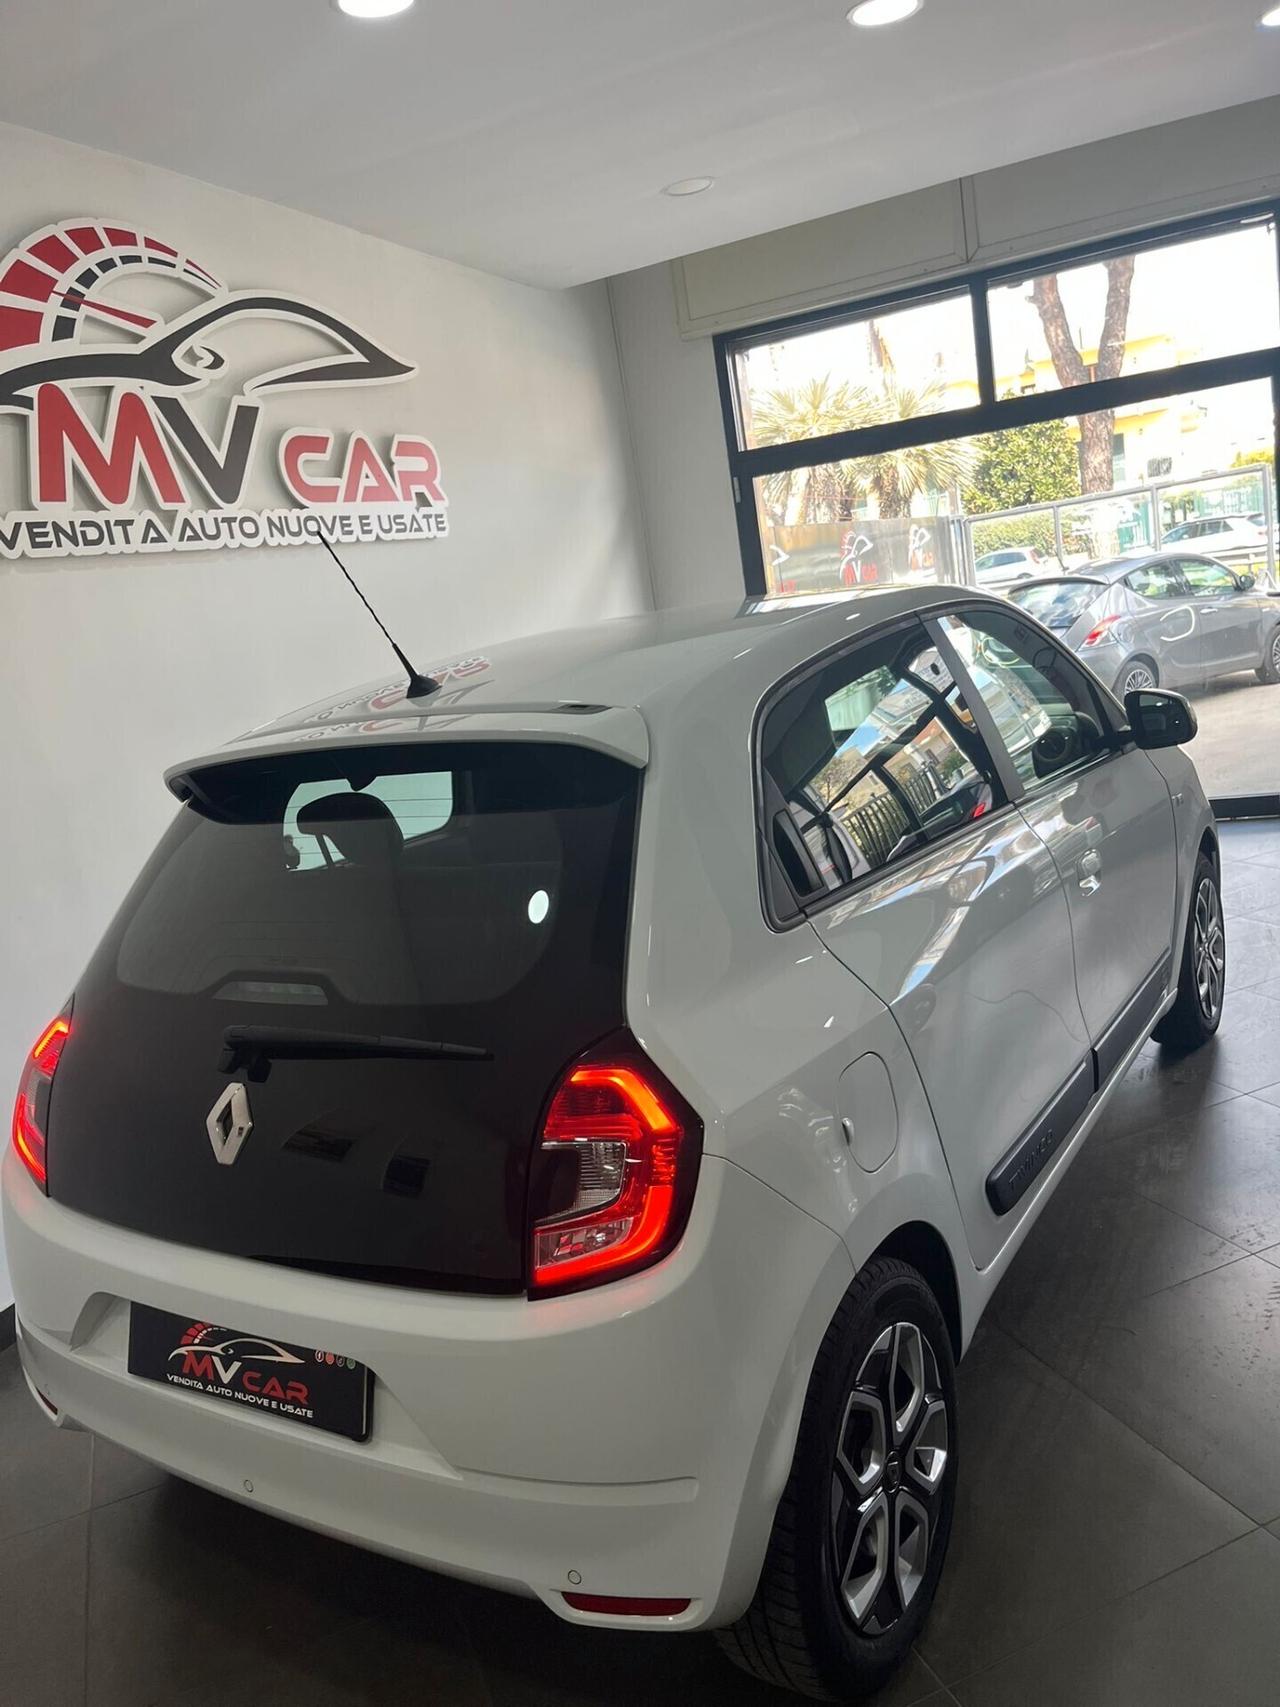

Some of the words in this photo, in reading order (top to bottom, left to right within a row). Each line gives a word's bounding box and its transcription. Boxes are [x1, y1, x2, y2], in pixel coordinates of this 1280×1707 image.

[39, 383, 260, 505] MV
[283, 434, 446, 503] CAR
[0, 519, 168, 550] VENDITA
[178, 516, 260, 542] AUTO
[267, 514, 354, 538] NUOVE
[359, 515, 374, 535] E
[378, 513, 447, 534] USATE
[166, 1373, 204, 1390] VENDITA
[206, 1384, 233, 1397] AUTO
[234, 1391, 270, 1407] NUOVE
[271, 1401, 278, 1409] E
[279, 1402, 314, 1418] USATE
[182, 1350, 242, 1384] MV
[242, 1370, 308, 1405] CAR
